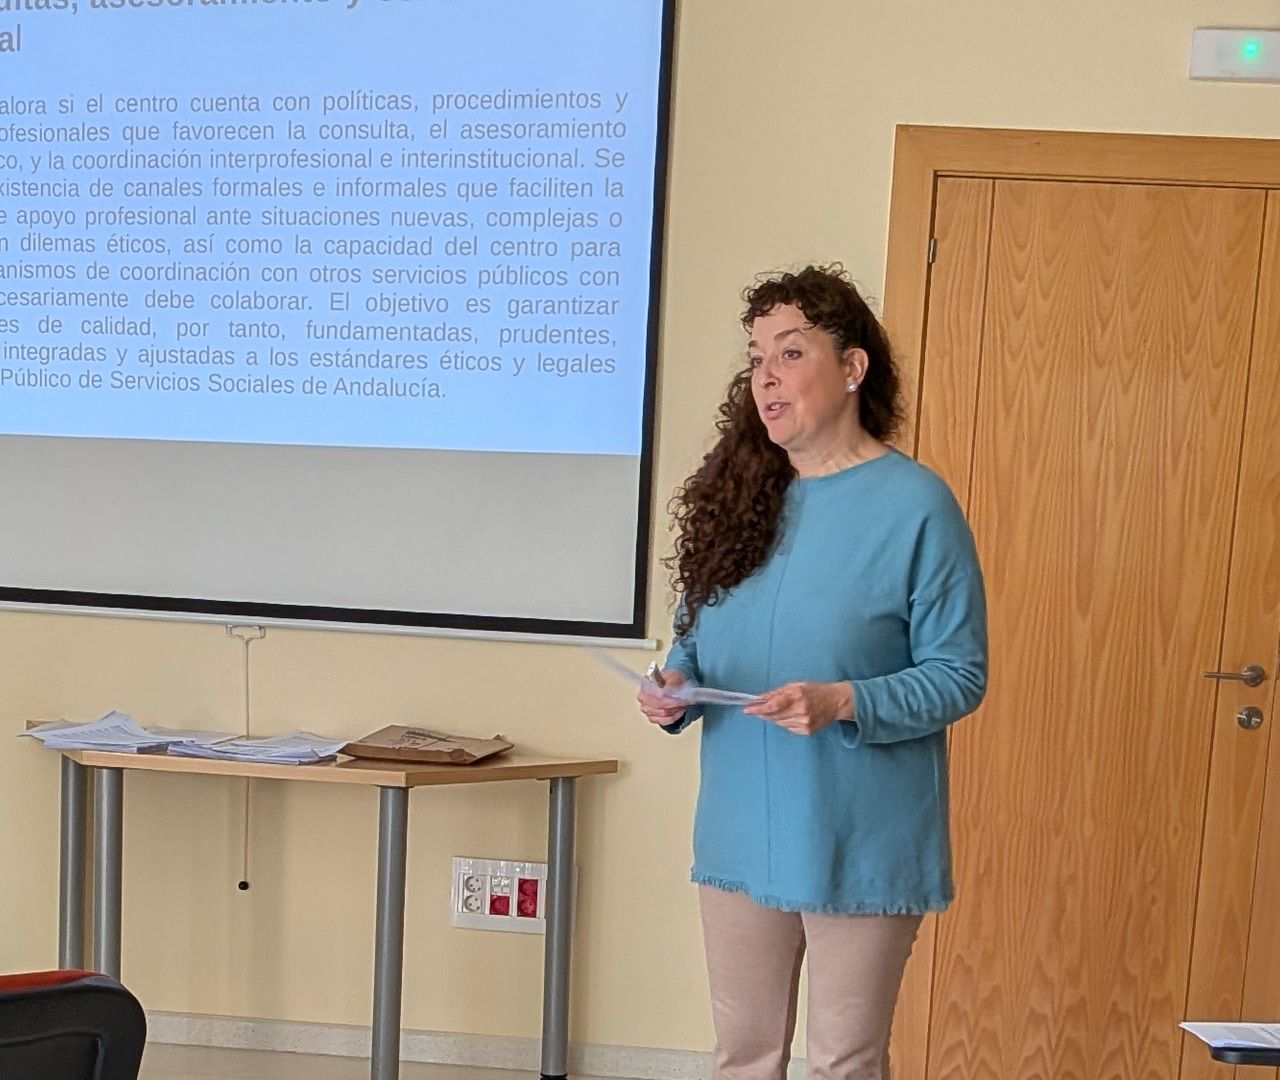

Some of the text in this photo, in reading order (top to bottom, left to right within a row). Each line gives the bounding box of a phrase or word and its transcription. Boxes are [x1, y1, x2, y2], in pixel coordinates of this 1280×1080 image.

[58, 93, 75, 115] si
[86, 92, 103, 114] el
[114, 94, 178, 113] centro
[190, 93, 261, 113] cuenta
[272, 95, 311, 112] con
[323, 88, 419, 117] políticas,
[432, 87, 602, 116] procedimientos
[615, 92, 629, 114] y
[121, 125, 161, 146] que
[171, 120, 275, 141] favorecen
[288, 119, 307, 141] la
[318, 118, 415, 142] consulta,
[429, 117, 448, 140] el
[460, 117, 627, 140] asesoramiento
[29, 155, 42, 175] y
[48, 149, 67, 171] la
[72, 147, 202, 170] coordinación
[209, 147, 373, 174] interprofesional
[379, 152, 393, 169] e
[401, 146, 585, 169] interinstitucional.
[594, 147, 626, 169] Se
[89, 177, 114, 198] de
[123, 176, 203, 198] canales
[211, 176, 303, 198] formales
[312, 181, 326, 198] e
[335, 176, 448, 199] informales
[457, 181, 498, 204] que
[508, 176, 593, 199] faciliten
[604, 176, 625, 198] la
[16, 209, 77, 230] apoyo
[85, 204, 197, 231] profesional
[206, 207, 252, 226] ante
[260, 205, 381, 227] situaciones
[390, 210, 475, 230] nuevas,
[486, 206, 599, 233] complejas
[608, 211, 623, 228] o
[20, 231, 96, 254] dilemas
[106, 232, 171, 256] éticos,
[183, 232, 216, 254] así
[225, 238, 283, 255] como
[294, 233, 313, 255] la
[323, 234, 433, 260] capacidad
[444, 235, 478, 257] del
[489, 237, 558, 257] centro
[570, 240, 622, 263] para
[85, 260, 111, 281] de
[119, 260, 250, 282] coordinación
[261, 266, 298, 283] con
[309, 264, 362, 284] otros
[371, 263, 467, 285] servicios
[477, 263, 569, 290] públicos
[579, 270, 620, 287] con
[144, 288, 195, 310] debe
[210, 289, 313, 311] colaborar.
[329, 291, 350, 312] El
[365, 291, 449, 318] objetivo
[465, 297, 491, 314] es
[507, 294, 621, 320] garantizar
[37, 314, 63, 334] de
[80, 315, 157, 339] calidad,
[176, 321, 210, 342] por
[228, 320, 286, 342] tanto,
[305, 319, 479, 345] fundamentadas,
[499, 323, 616, 349] prudentes,
[3, 340, 108, 366] integradas
[115, 347, 129, 367] y
[137, 343, 236, 368] ajustadas
[245, 350, 259, 367] a
[269, 346, 299, 367] los
[309, 347, 429, 370] estándares
[439, 348, 503, 372] éticos
[512, 356, 526, 377] y
[537, 351, 617, 378] legales
[0, 367, 72, 389] Público
[78, 368, 103, 389] de
[109, 370, 201, 392] Servicios
[207, 372, 295, 395] Sociales
[301, 375, 328, 396] de
[332, 376, 446, 399] Andalucía.
